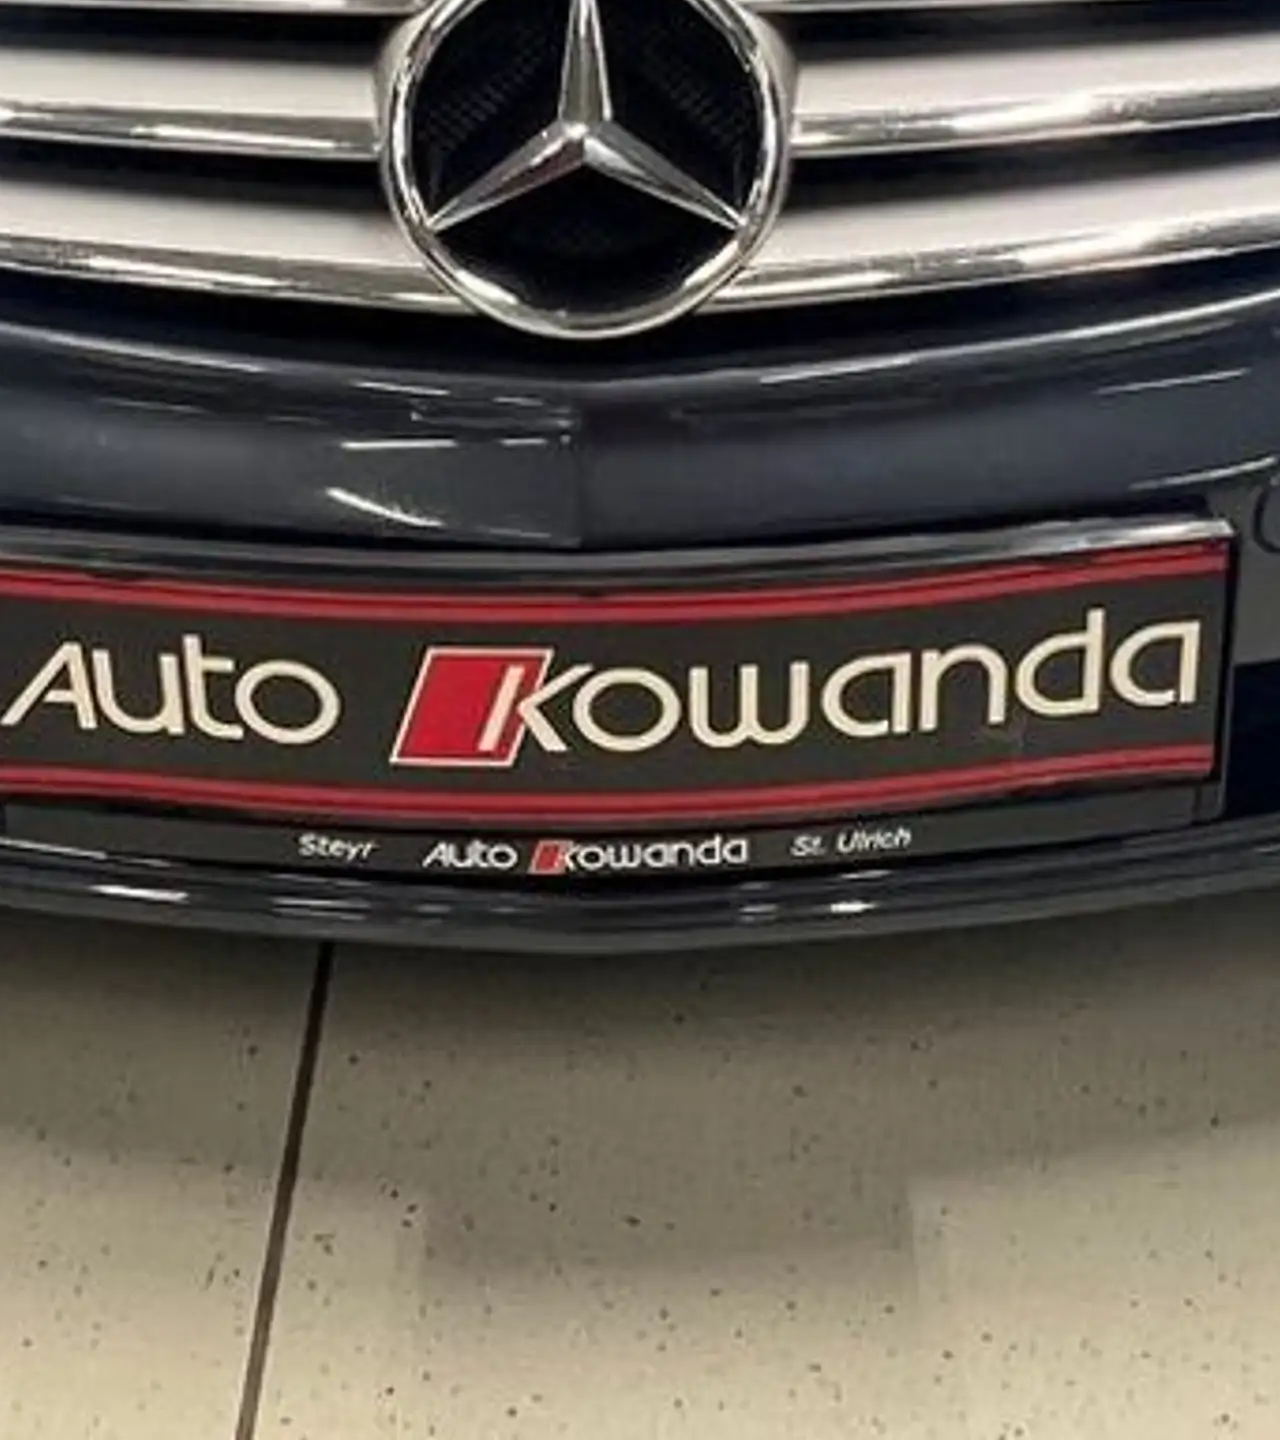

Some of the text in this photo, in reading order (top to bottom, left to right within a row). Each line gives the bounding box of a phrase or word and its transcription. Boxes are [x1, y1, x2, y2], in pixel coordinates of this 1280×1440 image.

[0, 634, 341, 746] Auto
[298, 832, 377, 862] Steyr
[422, 839, 518, 870] Auto
[836, 826, 912, 853] Ulrich
